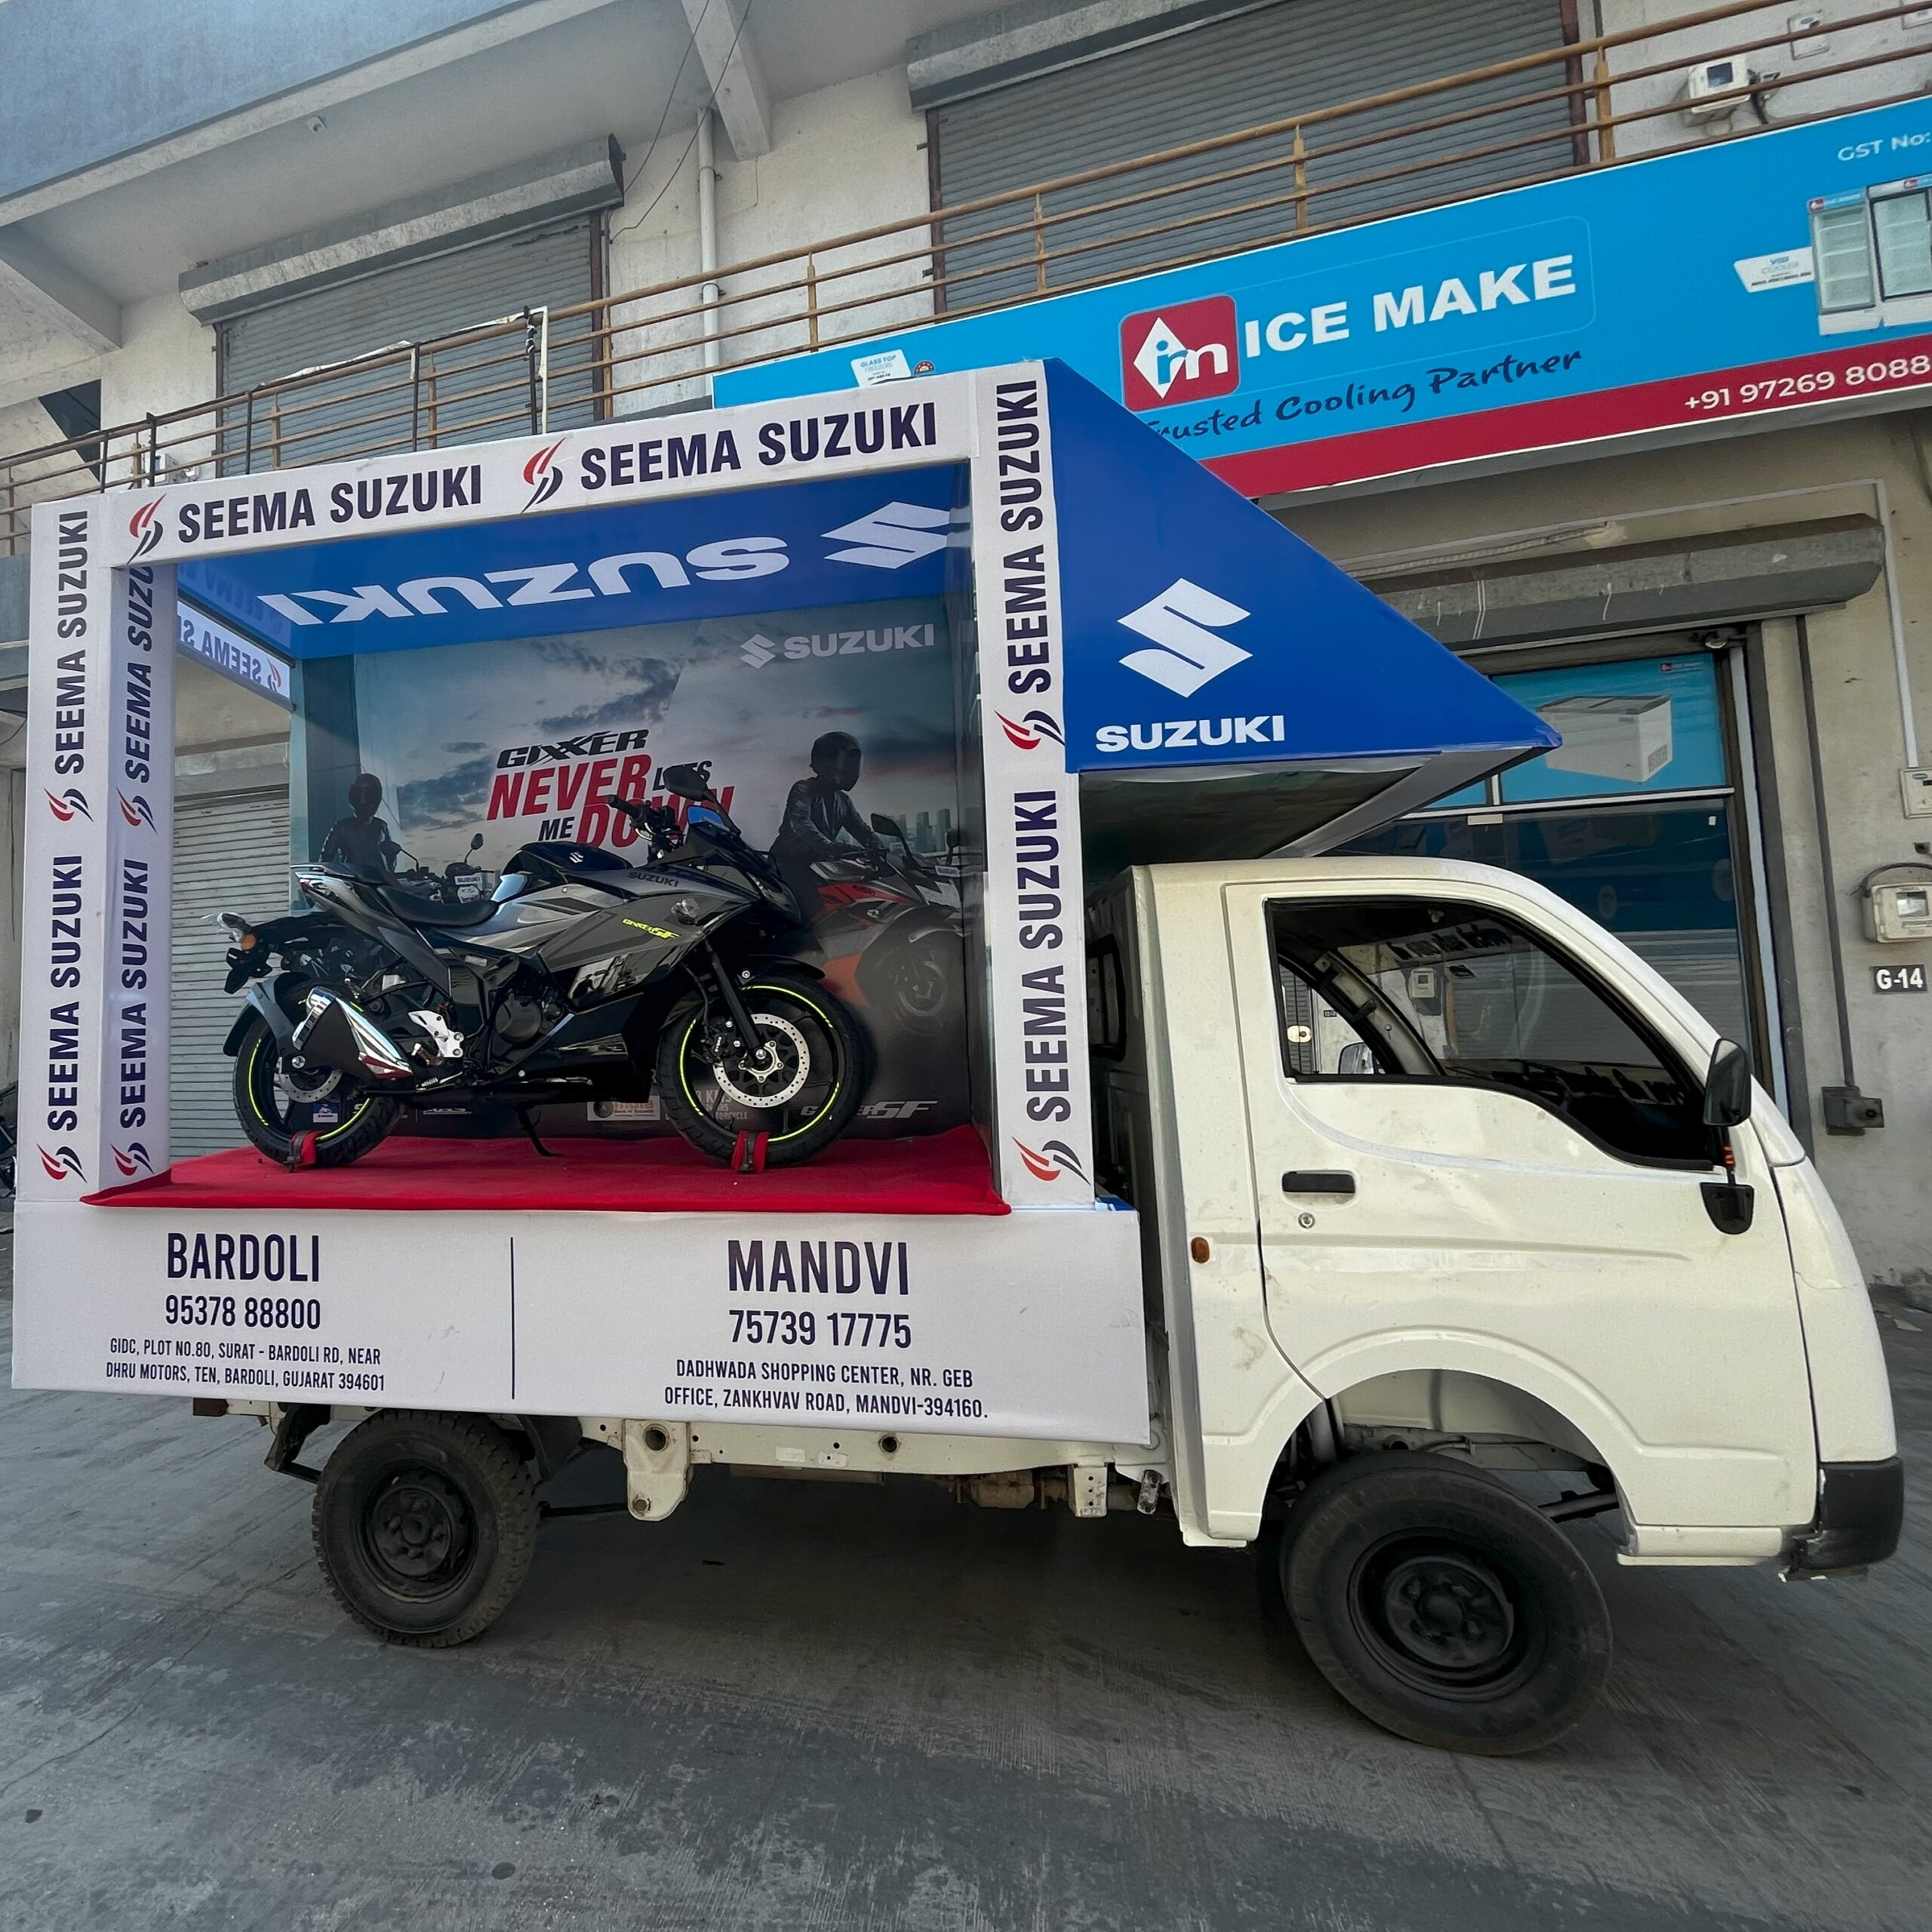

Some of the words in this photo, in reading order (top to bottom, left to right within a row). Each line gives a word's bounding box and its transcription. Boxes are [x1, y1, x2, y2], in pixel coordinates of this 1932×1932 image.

[1838, 139, 1884, 161] GST
[1890, 132, 1931, 150] No:
[1244, 301, 1350, 358] ICE
[1373, 254, 1577, 333] MAKE
[1146, 399, 1262, 440] usted
[1275, 381, 1416, 420] Cooling
[1426, 349, 1583, 395] Partner
[1684, 388, 1730, 410] +91
[1740, 371, 1835, 403] 97269
[1844, 355, 1930, 386] 8088
[580, 429, 742, 491] SEEMA
[758, 402, 937, 466] SUZUKI
[996, 380, 1044, 532] SUZUKI
[178, 488, 315, 543] SEEMA
[330, 464, 481, 523] SUZUKI
[57, 510, 88, 638] SUZUKI
[128, 565, 154, 651] SUZU
[257, 537, 790, 626] SUZUKI
[784, 623, 935, 660] SUZUKI
[1003, 544, 1051, 694] SEEMA
[54, 649, 87, 774] SEEMA
[125, 662, 152, 783] SEEMA
[1096, 715, 1285, 752] SUZUKI
[497, 729, 649, 769] GIXXER
[487, 754, 652, 820] NEVER
[538, 817, 575, 841] ME
[628, 872, 679, 888] SUZUKI
[1014, 790, 1063, 949] SUZUKI
[51, 855, 82, 989] SUZUKI
[122, 859, 149, 990] SUZUKI
[1876, 968, 1924, 990] G-14
[48, 1001, 80, 1131] SEEMA
[120, 1002, 147, 1128] SEEMA
[1021, 964, 1072, 1123] SEEMA
[167, 1232, 320, 1282] BARDOLI
[727, 1239, 909, 1296] MANDVI
[165, 1294, 236, 1327] 95378
[244, 1297, 321, 1330] 88800
[728, 1309, 817, 1346] 75739
[826, 1312, 912, 1349] 17775
[106, 1362, 136, 1380] DHRU
[140, 1364, 191, 1385] MOTORS,
[194, 1367, 220, 1386] TEN,
[224, 1369, 279, 1390] BARDOLI,
[282, 1371, 336, 1389] GUJARAT
[338, 1373, 385, 1392] 394601
[109, 1337, 140, 1356] GIDC,
[143, 1340, 172, 1356] PLOT
[175, 1341, 214, 1360] NO.80,
[218, 1343, 255, 1360] SURAT
[268, 1344, 320, 1363] BARDOLI
[324, 1347, 344, 1367] RD,
[347, 1347, 381, 1365] NEAR
[676, 1358, 756, 1380] DADHWADA
[761, 1362, 836, 1383] SHOPPING
[841, 1364, 905, 1387] CENTER,
[909, 1368, 938, 1387] NR.
[943, 1368, 974, 1388] GEB
[664, 1386, 719, 1409] OFFICE,
[722, 1388, 800, 1410] ZANKHVAV
[805, 1392, 851, 1415] ROAD,
[856, 1395, 989, 1419] MANDVI-394160.
